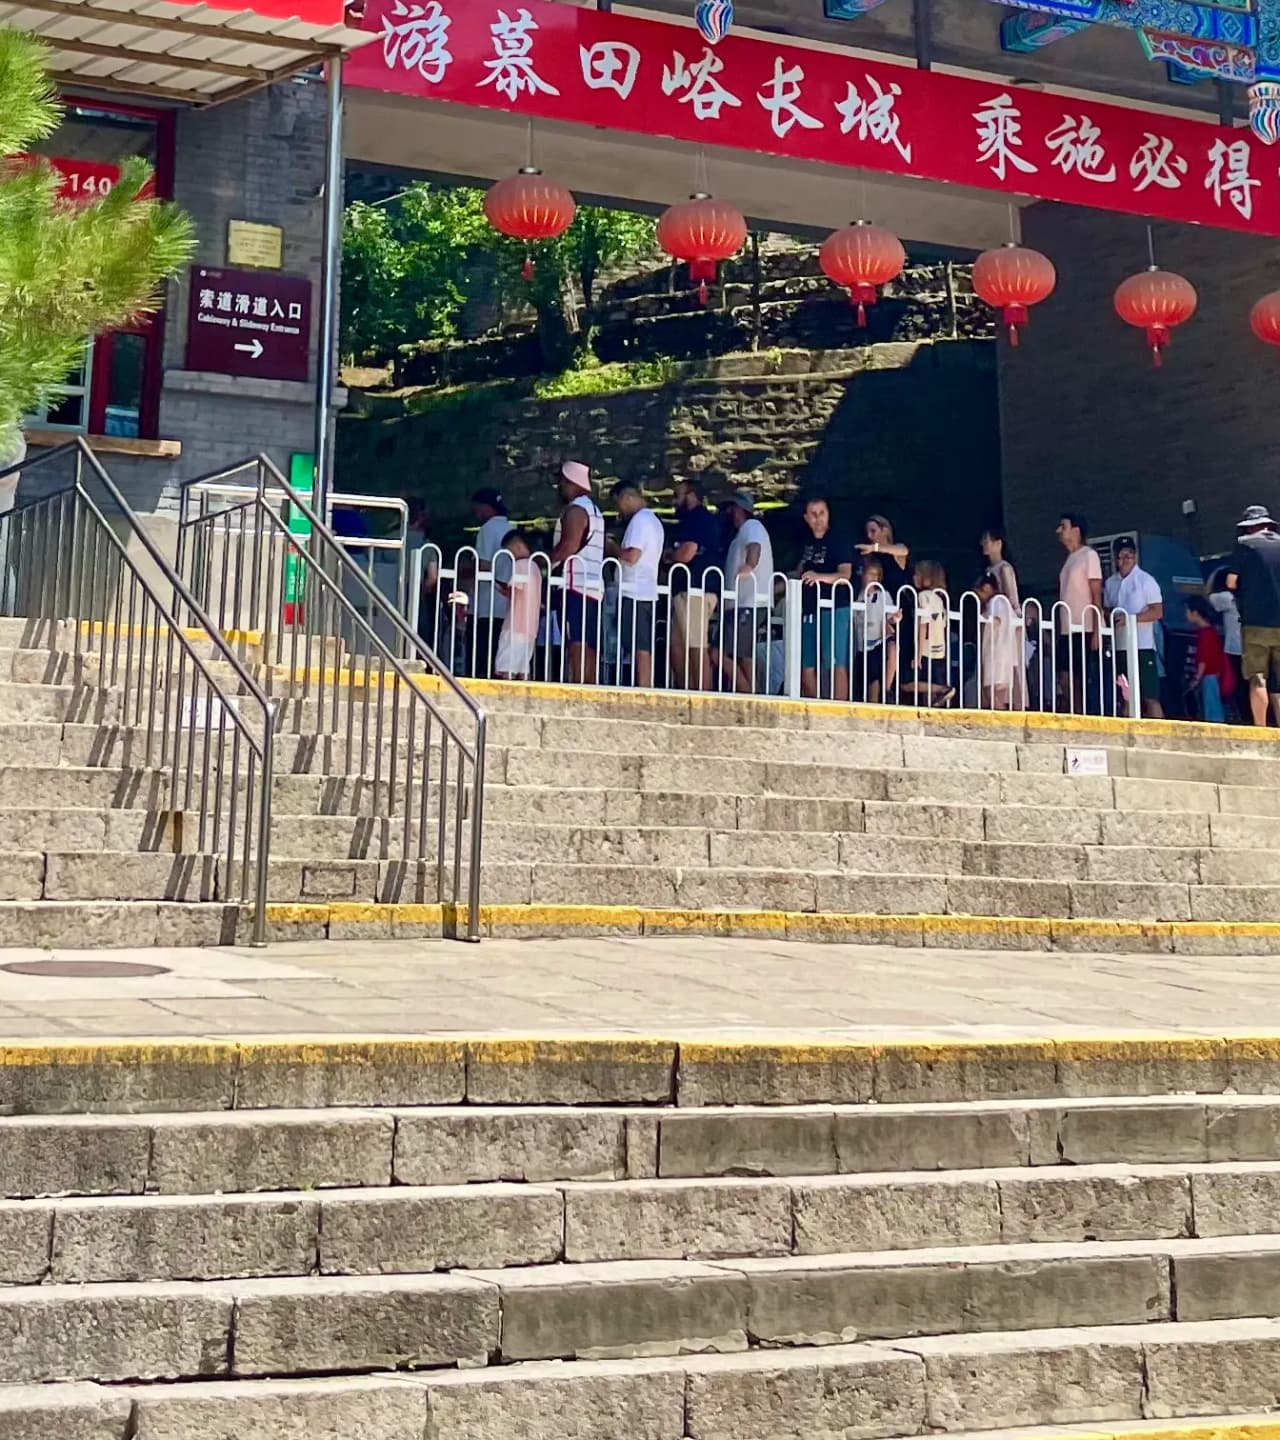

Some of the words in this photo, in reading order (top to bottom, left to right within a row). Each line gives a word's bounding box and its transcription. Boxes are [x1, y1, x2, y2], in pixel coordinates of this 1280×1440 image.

[68, 173, 113, 196] 140
[199, 289, 302, 320] 索道滑道入口
[270, 322, 300, 335] Entrance
